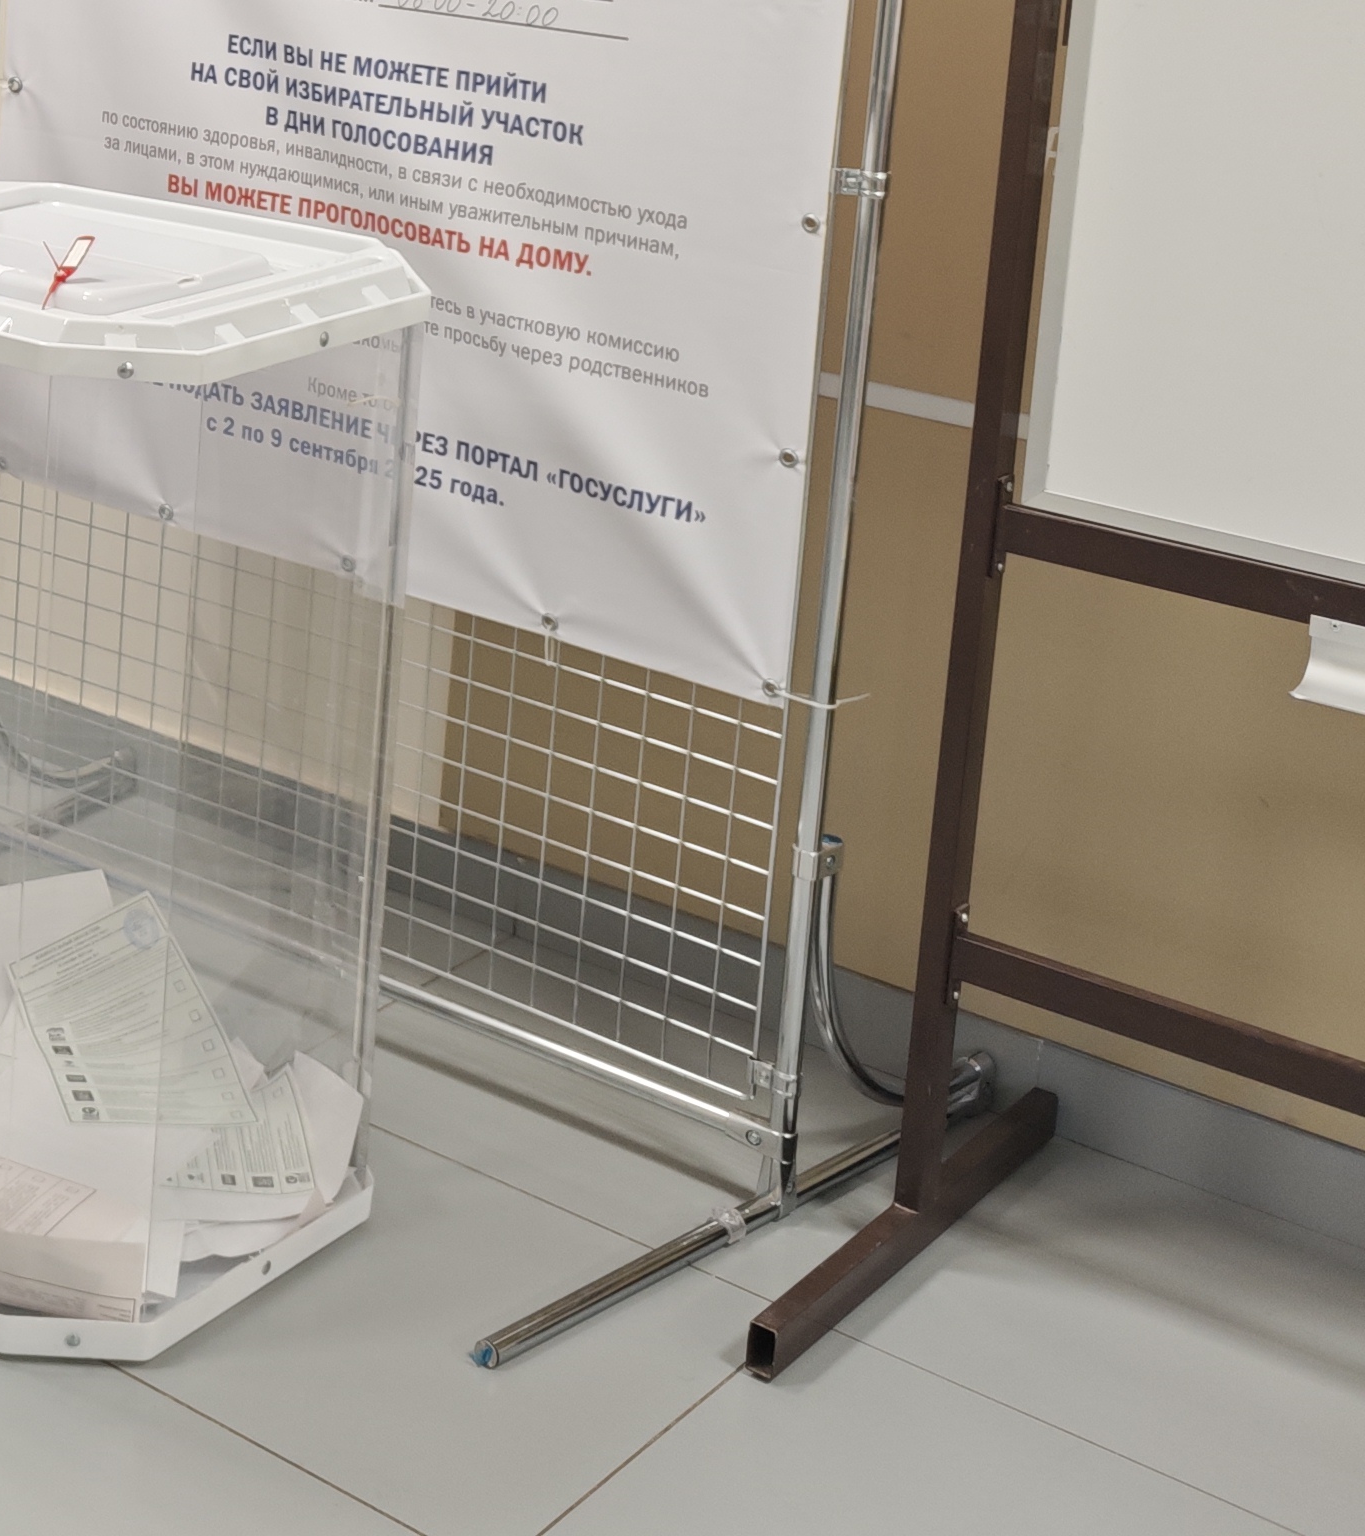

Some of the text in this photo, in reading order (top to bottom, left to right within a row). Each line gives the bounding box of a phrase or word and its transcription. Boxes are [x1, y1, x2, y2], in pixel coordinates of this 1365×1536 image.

[190, 61, 584, 146] НА СВОЙ ИЗБИРАТЕЛЬНЫЙ УЧАСТОК
[227, 33, 547, 104] ЕСЛИ ВЫ НЕ МОЖЕТЕ ПРИЙТИ
[101, 110, 688, 231] по состоянию здоровья, инвалидности, в связи с необходимостью ухода
[265, 105, 494, 166] В ДНИ ГОЛОСОВАНИЯ
[103, 136, 679, 261] за лицами, в этом нуждающимися, или иным уважительным причинам,
[167, 173, 592, 277] ВЫ МОЖЕТЕ ПРОГОЛОСОВАТЬ НА ДОМУ.
[443, 325, 507, 358] просьбу
[511, 343, 563, 368] через
[568, 355, 709, 398] родственников
[466, 305, 475, 320] в
[479, 308, 581, 343] участковую
[586, 329, 680, 363] комиссию
[307, 376, 358, 403] Кроме
[206, 416, 218, 432] с
[222, 416, 235, 437] 2
[241, 425, 265, 445] по
[270, 428, 283, 449] 9
[289, 434, 379, 476] сентября
[449, 476, 505, 507] года.
[250, 390, 373, 440] ЗАЯВЛЕНИЕ
[455, 439, 538, 483] ПОРТАЛ
[546, 468, 706, 524] «ГОСУСЛУГИ»
